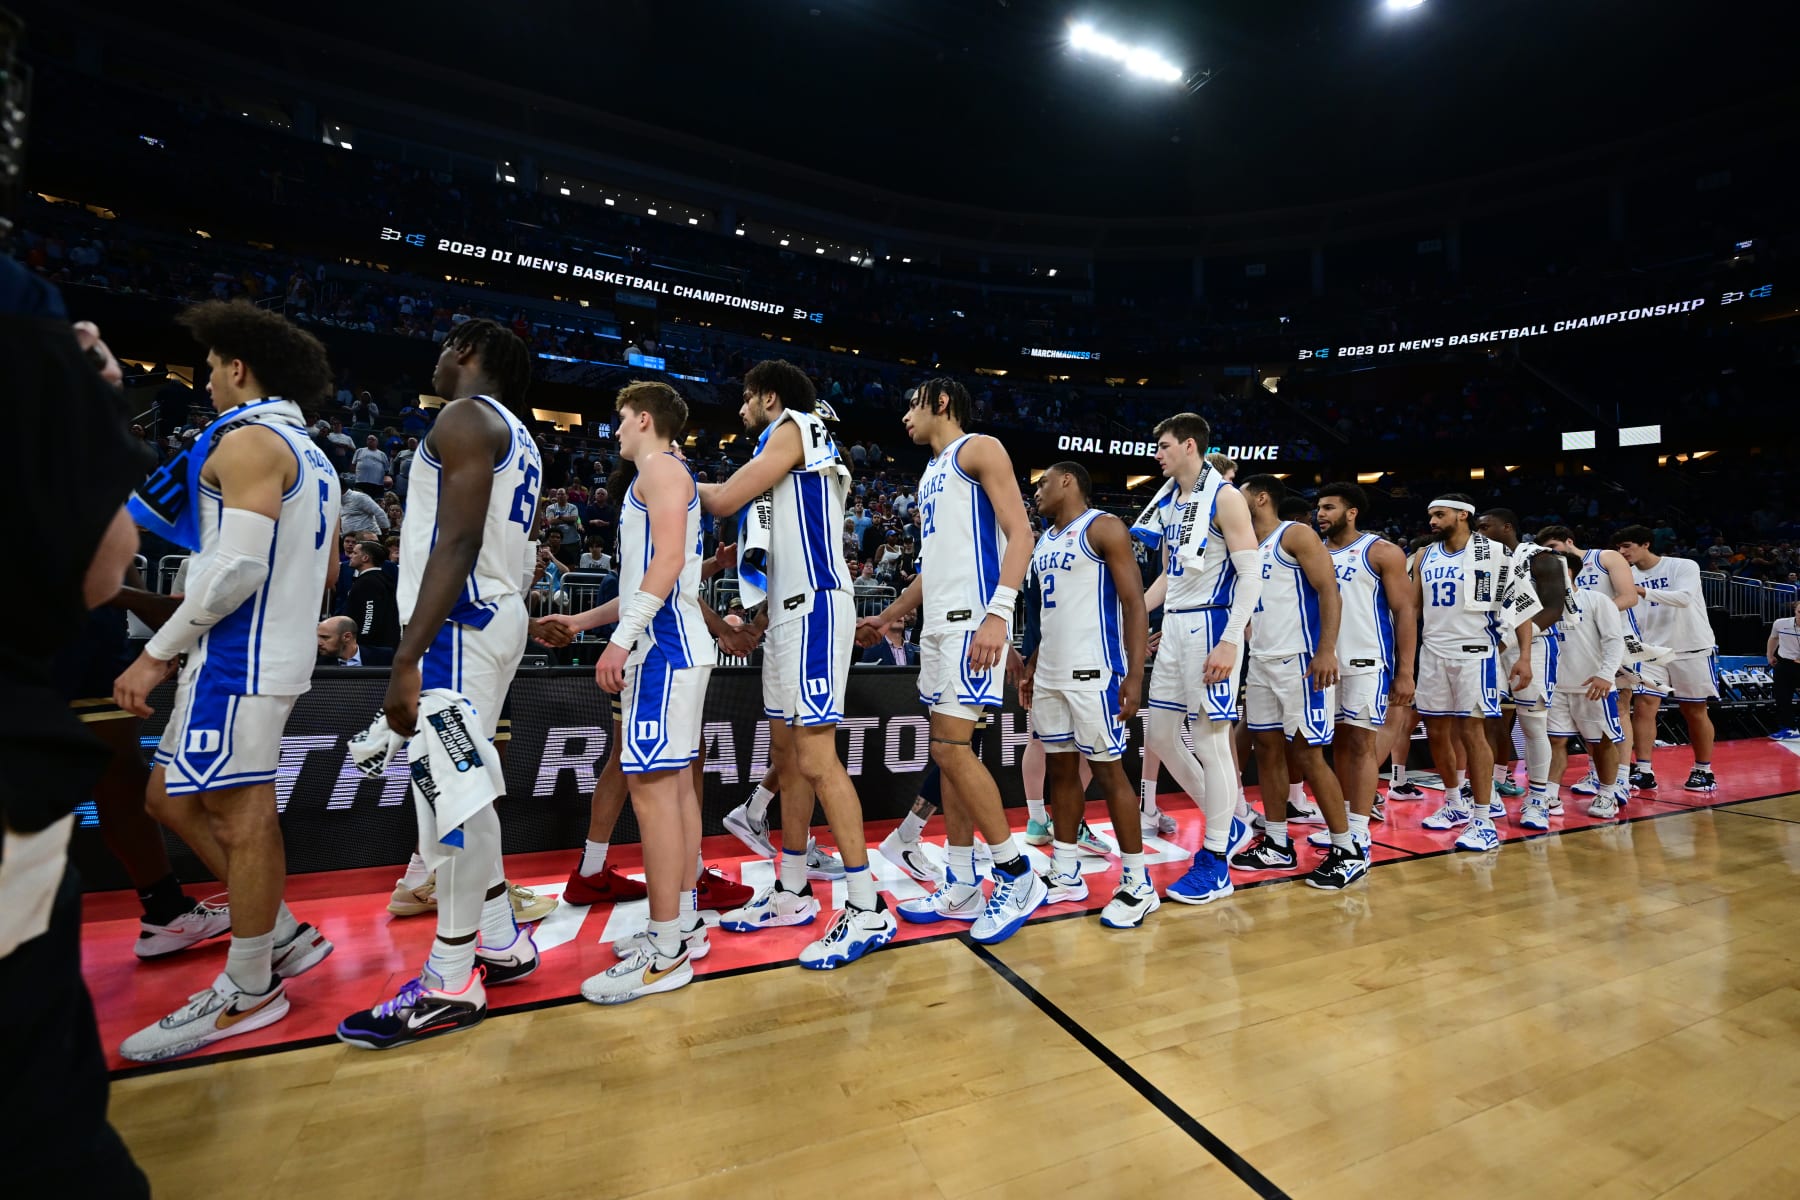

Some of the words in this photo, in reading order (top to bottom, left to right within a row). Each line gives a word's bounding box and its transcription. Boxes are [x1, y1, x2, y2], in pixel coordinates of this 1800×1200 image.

[438, 239, 486, 259] 2023
[492, 250, 513, 264] DI
[517, 255, 569, 274] MEN'S
[573, 266, 669, 294] BASKETBALL
[674, 286, 785, 315] CHAMPIONSHIP
[1338, 345, 1375, 357] 2023
[1378, 343, 1396, 354] DI
[1399, 338, 1445, 352] MEN'S
[1449, 325, 1548, 346] BASKETBALL
[1554, 299, 1705, 332] CHAMPIONSHIP
[1031, 348, 1091, 360] MARCHMADNESS
[1058, 436, 1104, 454] ORAL
[1109, 440, 1158, 457] ROBE
[1228, 445, 1280, 460] DUKE
[314, 479, 329, 550] 5
[922, 498, 936, 538] 21
[1332, 564, 1357, 582] KE
[1498, 565, 1509, 585] FINAL
[1577, 574, 1599, 587] KE
[1043, 574, 1056, 609] 2
[1431, 581, 1456, 607] 13
[361, 600, 374, 635] LOUISIANA
[186, 729, 219, 753] D
[441, 709, 474, 753] MADNESS
[636, 720, 660, 741] D
[439, 730, 467, 762] MARCH
